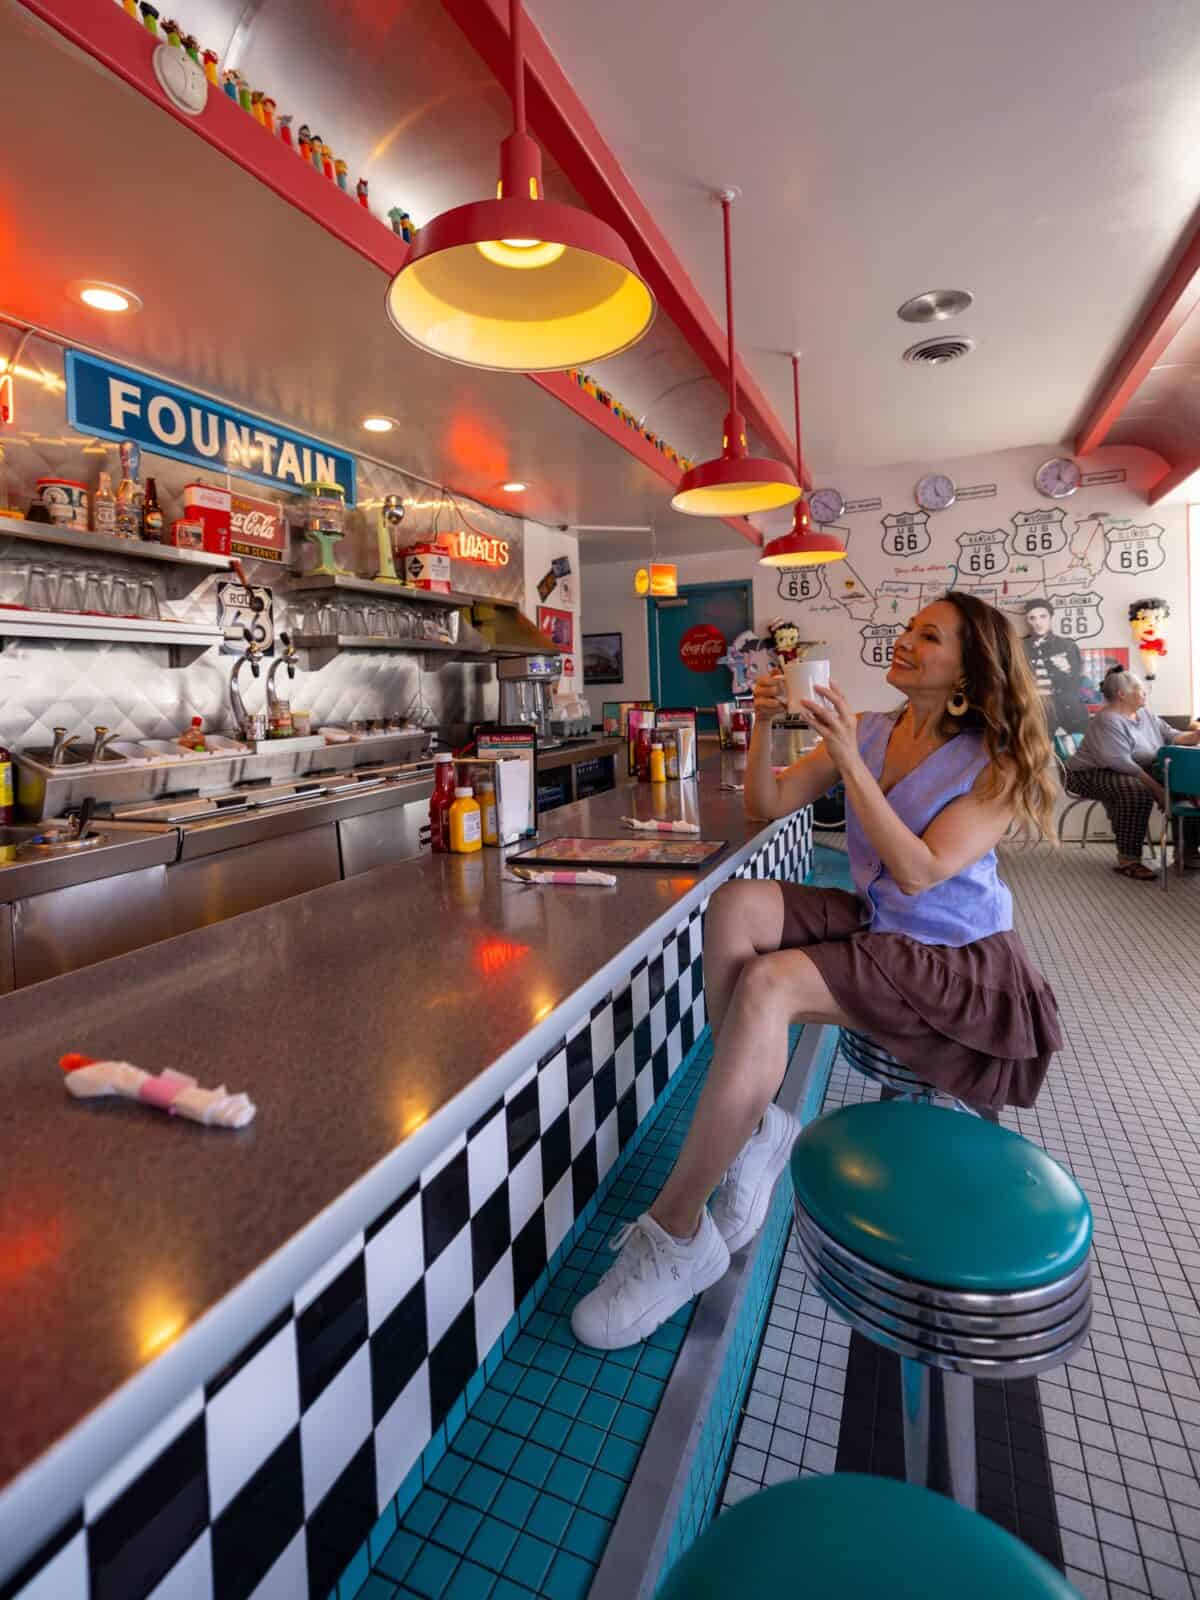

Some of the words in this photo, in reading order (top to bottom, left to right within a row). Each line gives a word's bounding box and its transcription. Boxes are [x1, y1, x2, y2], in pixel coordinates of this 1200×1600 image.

[108, 376, 336, 484] FOUNTAIN
[894, 533, 917, 551] 66
[1026, 532, 1052, 551] 66
[970, 553, 995, 571] 66
[1120, 549, 1149, 569] 66
[788, 580, 810, 597] 66
[229, 593, 252, 604] ROU
[1061, 616, 1088, 635] 66
[873, 646, 895, 662] 66
